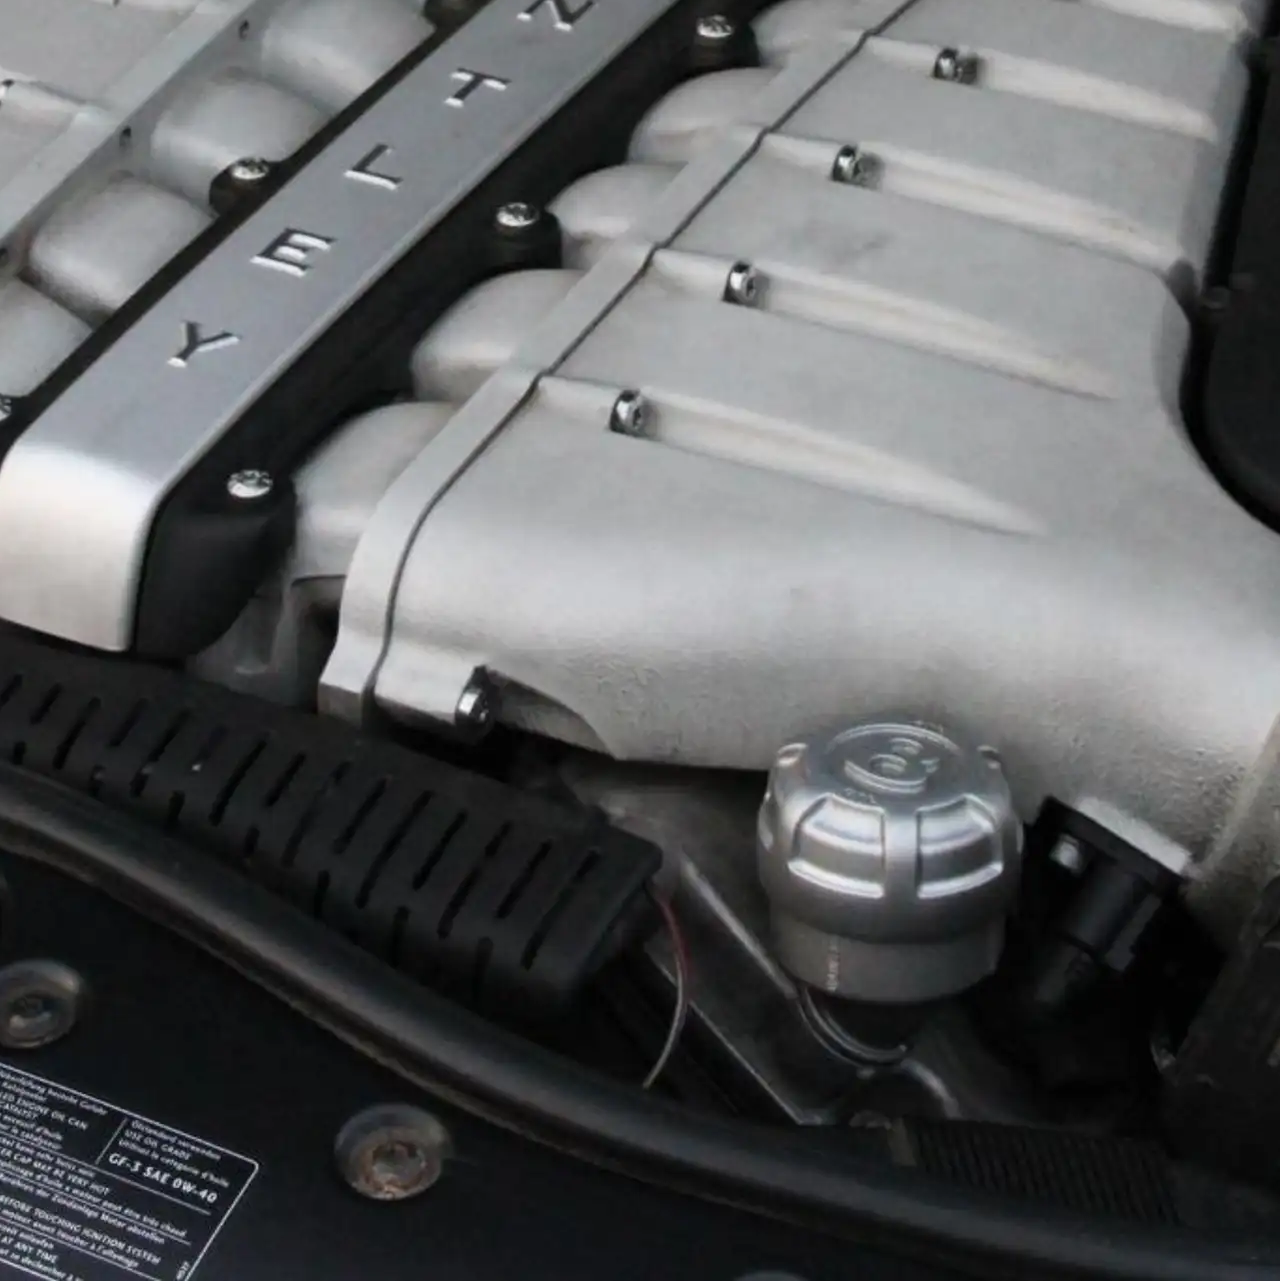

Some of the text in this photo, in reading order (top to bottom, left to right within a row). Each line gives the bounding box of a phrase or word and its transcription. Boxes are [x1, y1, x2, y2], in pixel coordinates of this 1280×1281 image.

[15, 1098, 49, 1114] ENGINE
[66, 1118, 88, 1129] CAN
[12, 1153, 32, 1164] CAP
[88, 1183, 109, 1195] HOT
[141, 1166, 171, 1184] SAE
[169, 1176, 219, 1202] 0W-40
[13, 1241, 33, 1253] ANY
[34, 1249, 59, 1263] TIME
[31, 1208, 81, 1232] TOUCHING
[80, 1227, 126, 1249] IGNITION
[124, 1245, 161, 1264] SYSTEM
